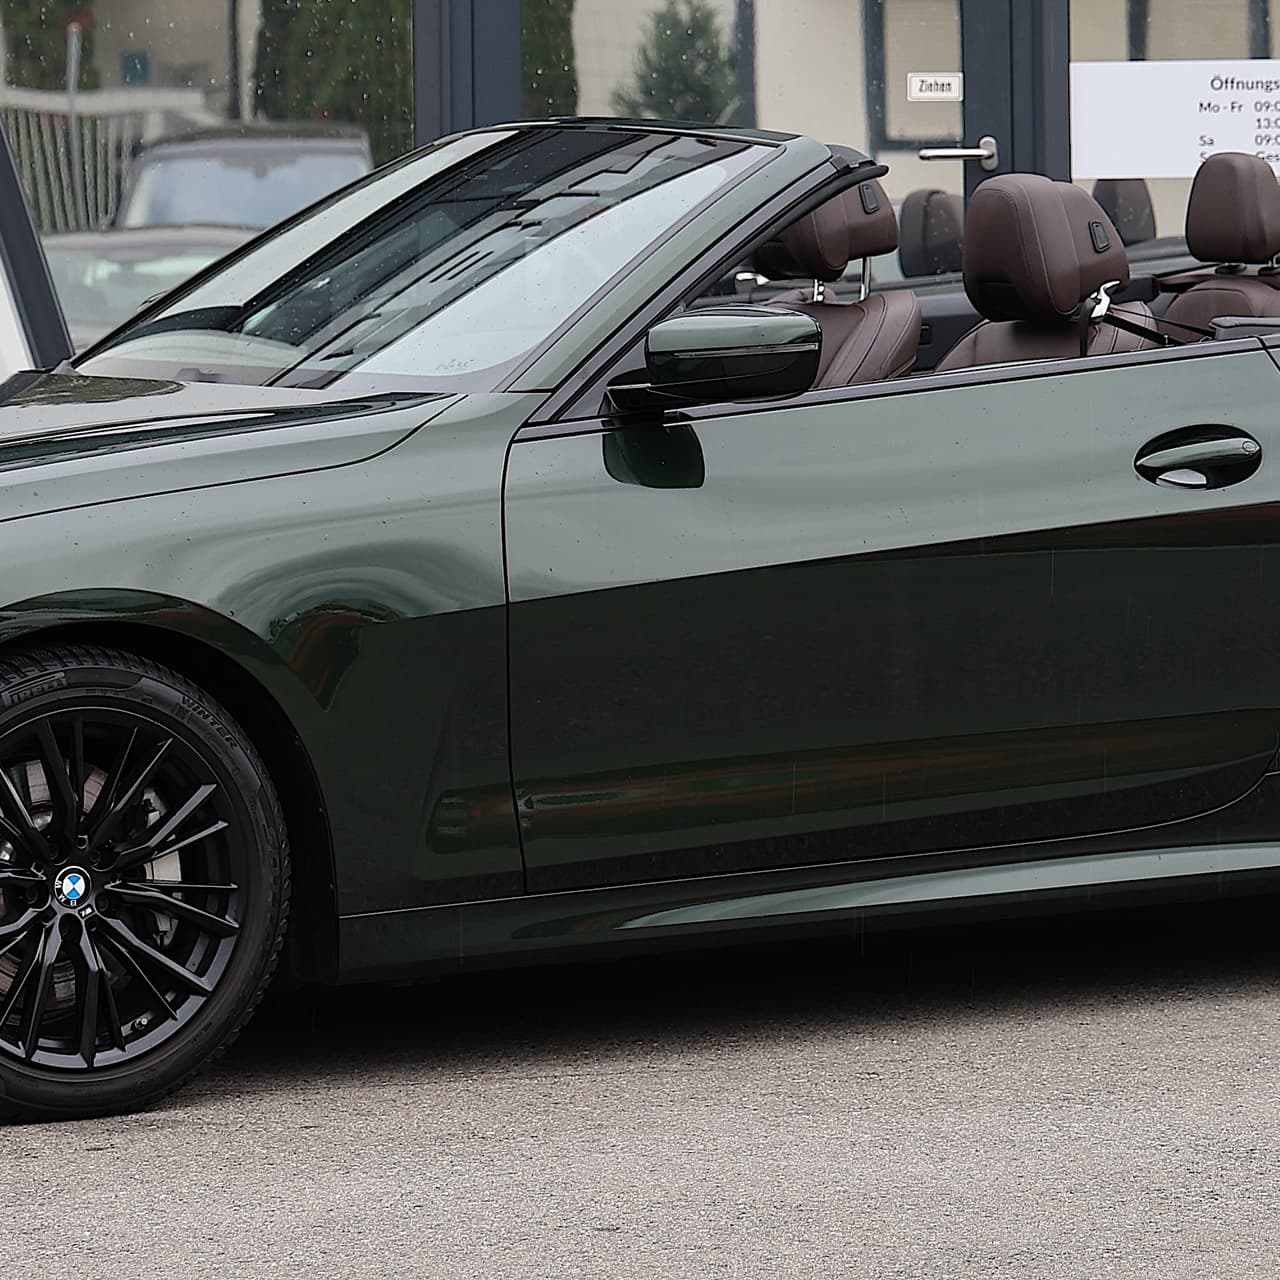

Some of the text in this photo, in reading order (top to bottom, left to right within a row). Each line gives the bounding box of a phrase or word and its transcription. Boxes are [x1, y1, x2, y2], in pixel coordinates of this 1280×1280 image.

[1199, 101, 1220, 113] Mo
[1230, 101, 1243, 112] Fr
[1199, 135, 1215, 146] Sa
[2, 672, 67, 707] PIRELLI
[182, 697, 239, 749] WINTER
